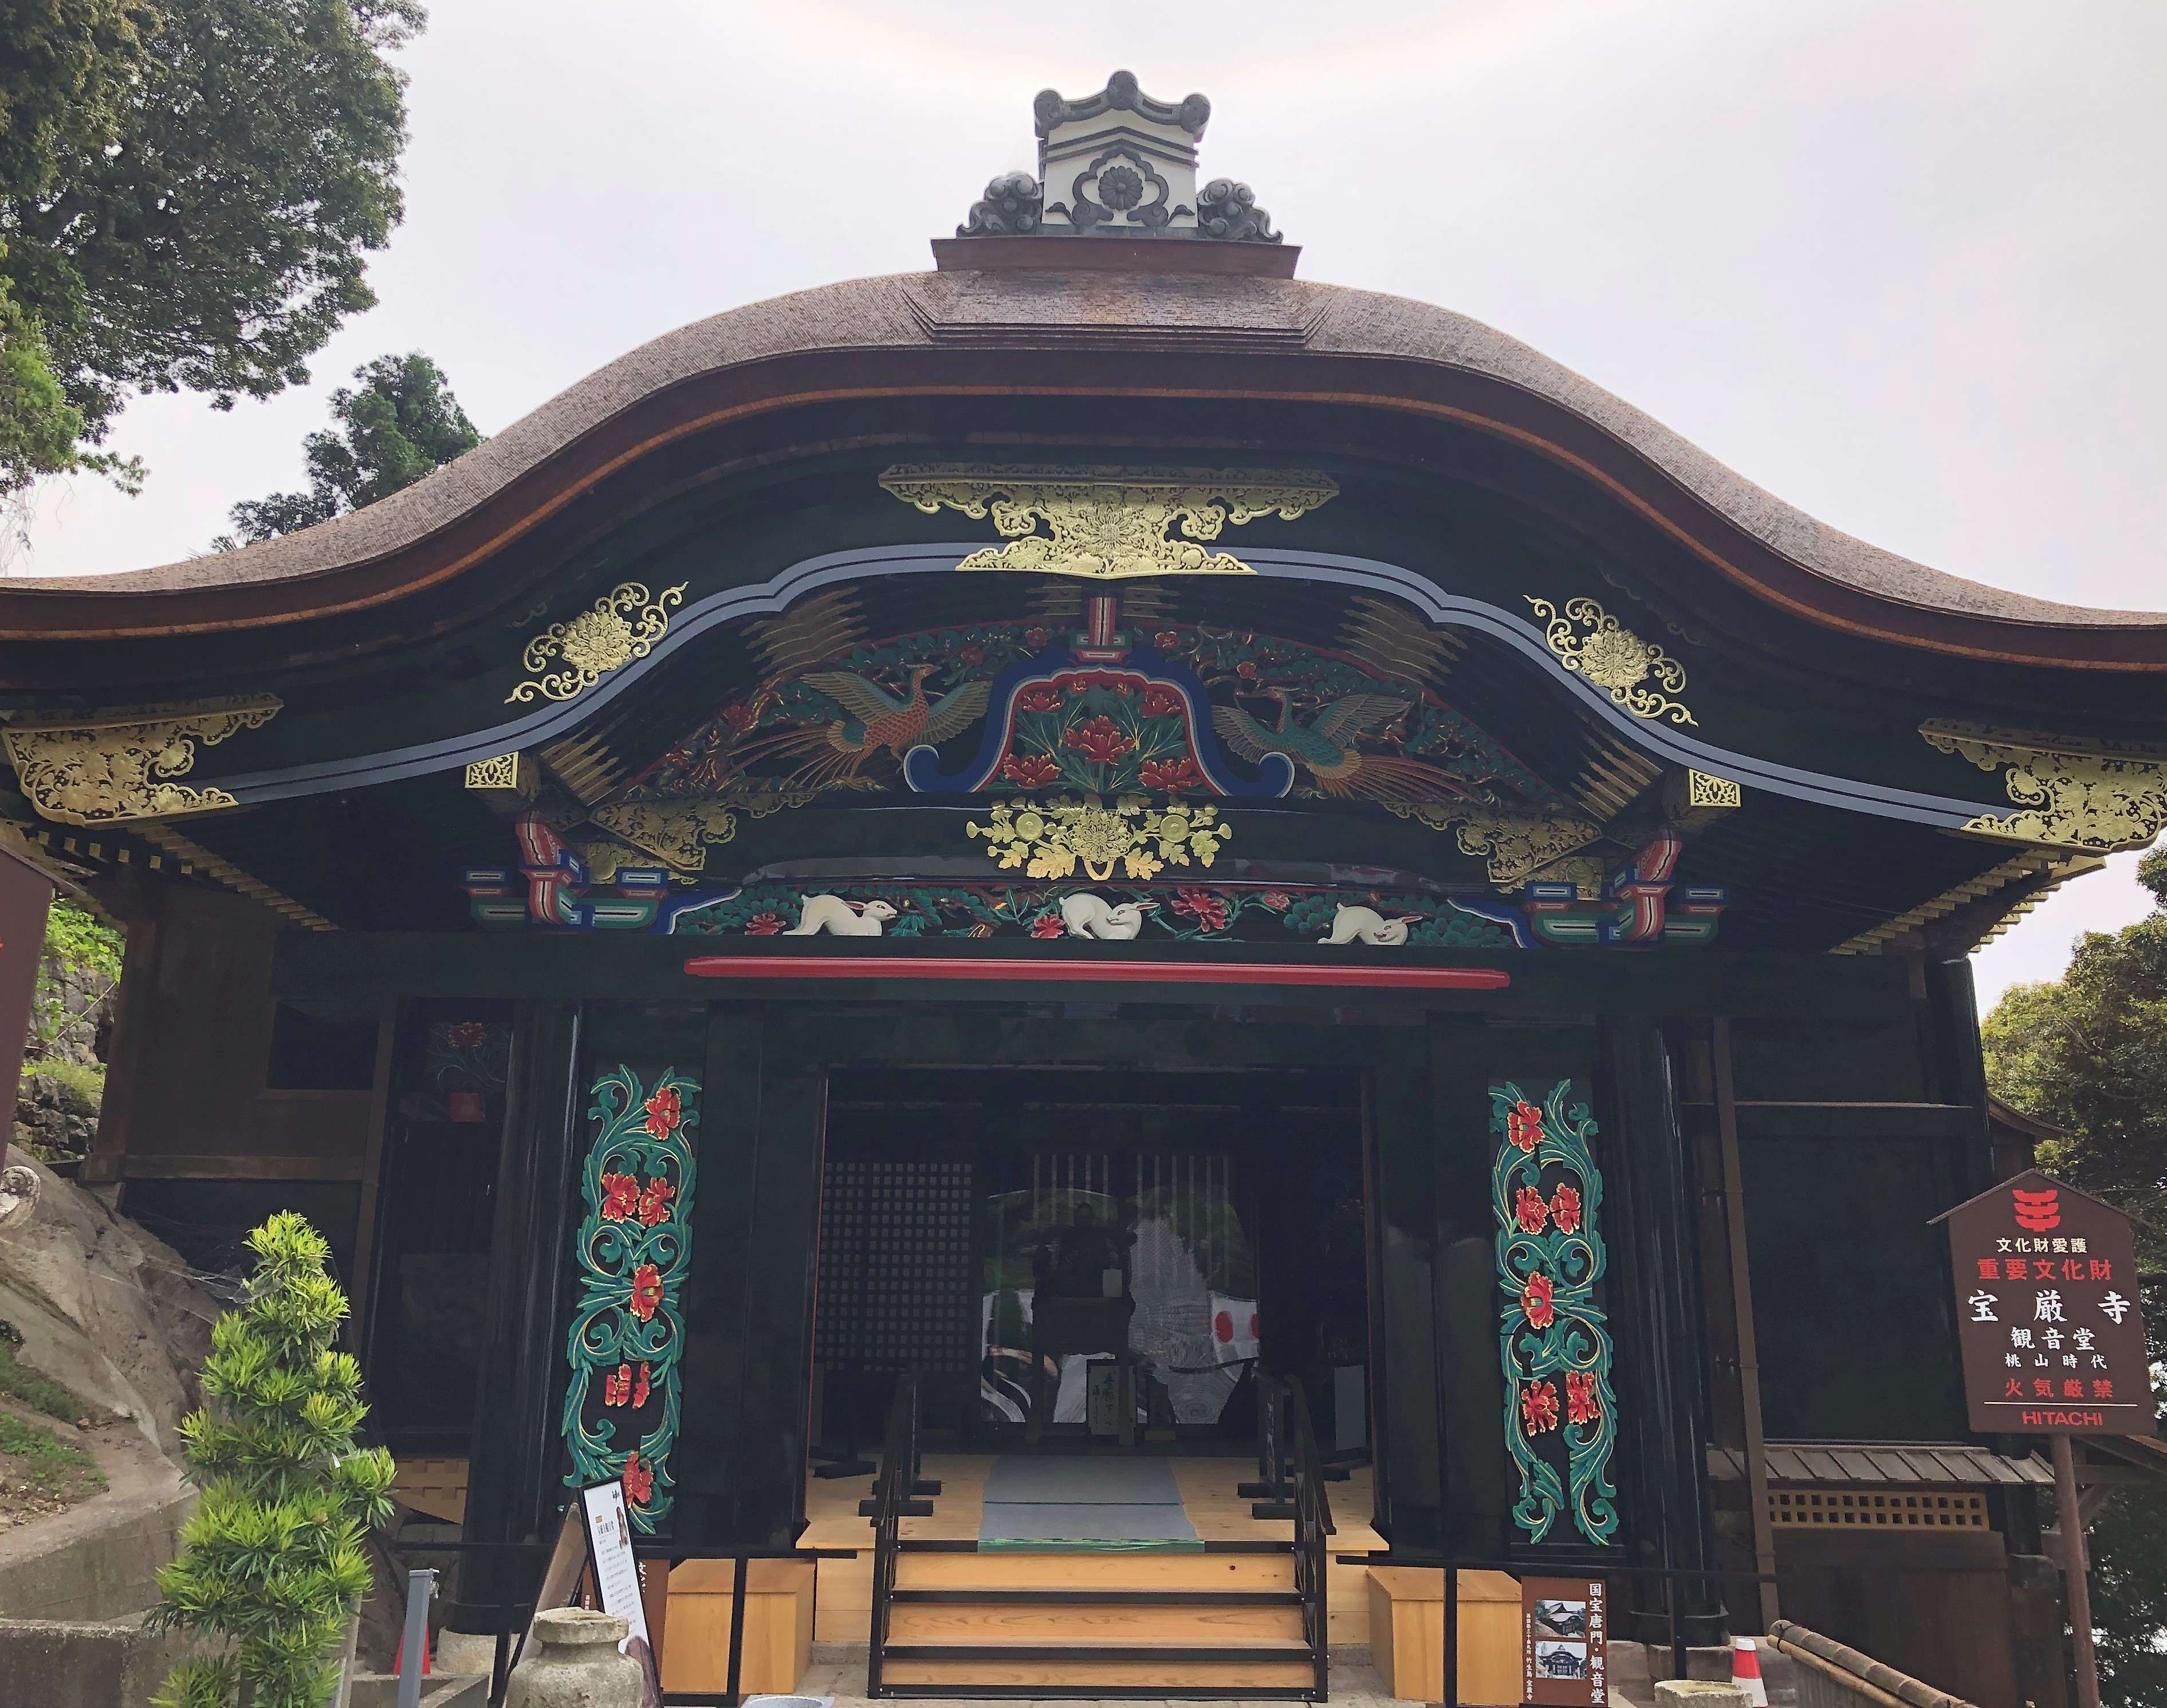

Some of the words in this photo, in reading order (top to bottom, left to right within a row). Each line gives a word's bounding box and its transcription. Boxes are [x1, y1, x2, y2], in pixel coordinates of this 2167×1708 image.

[1996, 1237, 2087, 1253] 文化財愛護
[1977, 1258, 2111, 1281] 重要文化財
[1968, 1289, 2131, 1325] 宝厳寺
[2011, 1327, 2095, 1351] 観音堂
[2005, 1353, 2107, 1369] 桃山時代
[2005, 1378, 2113, 1398] 火気厳禁
[2022, 1411, 2103, 1426] HITACHI
[1588, 1583, 1605, 1704] 国宝唐門・観音堂
